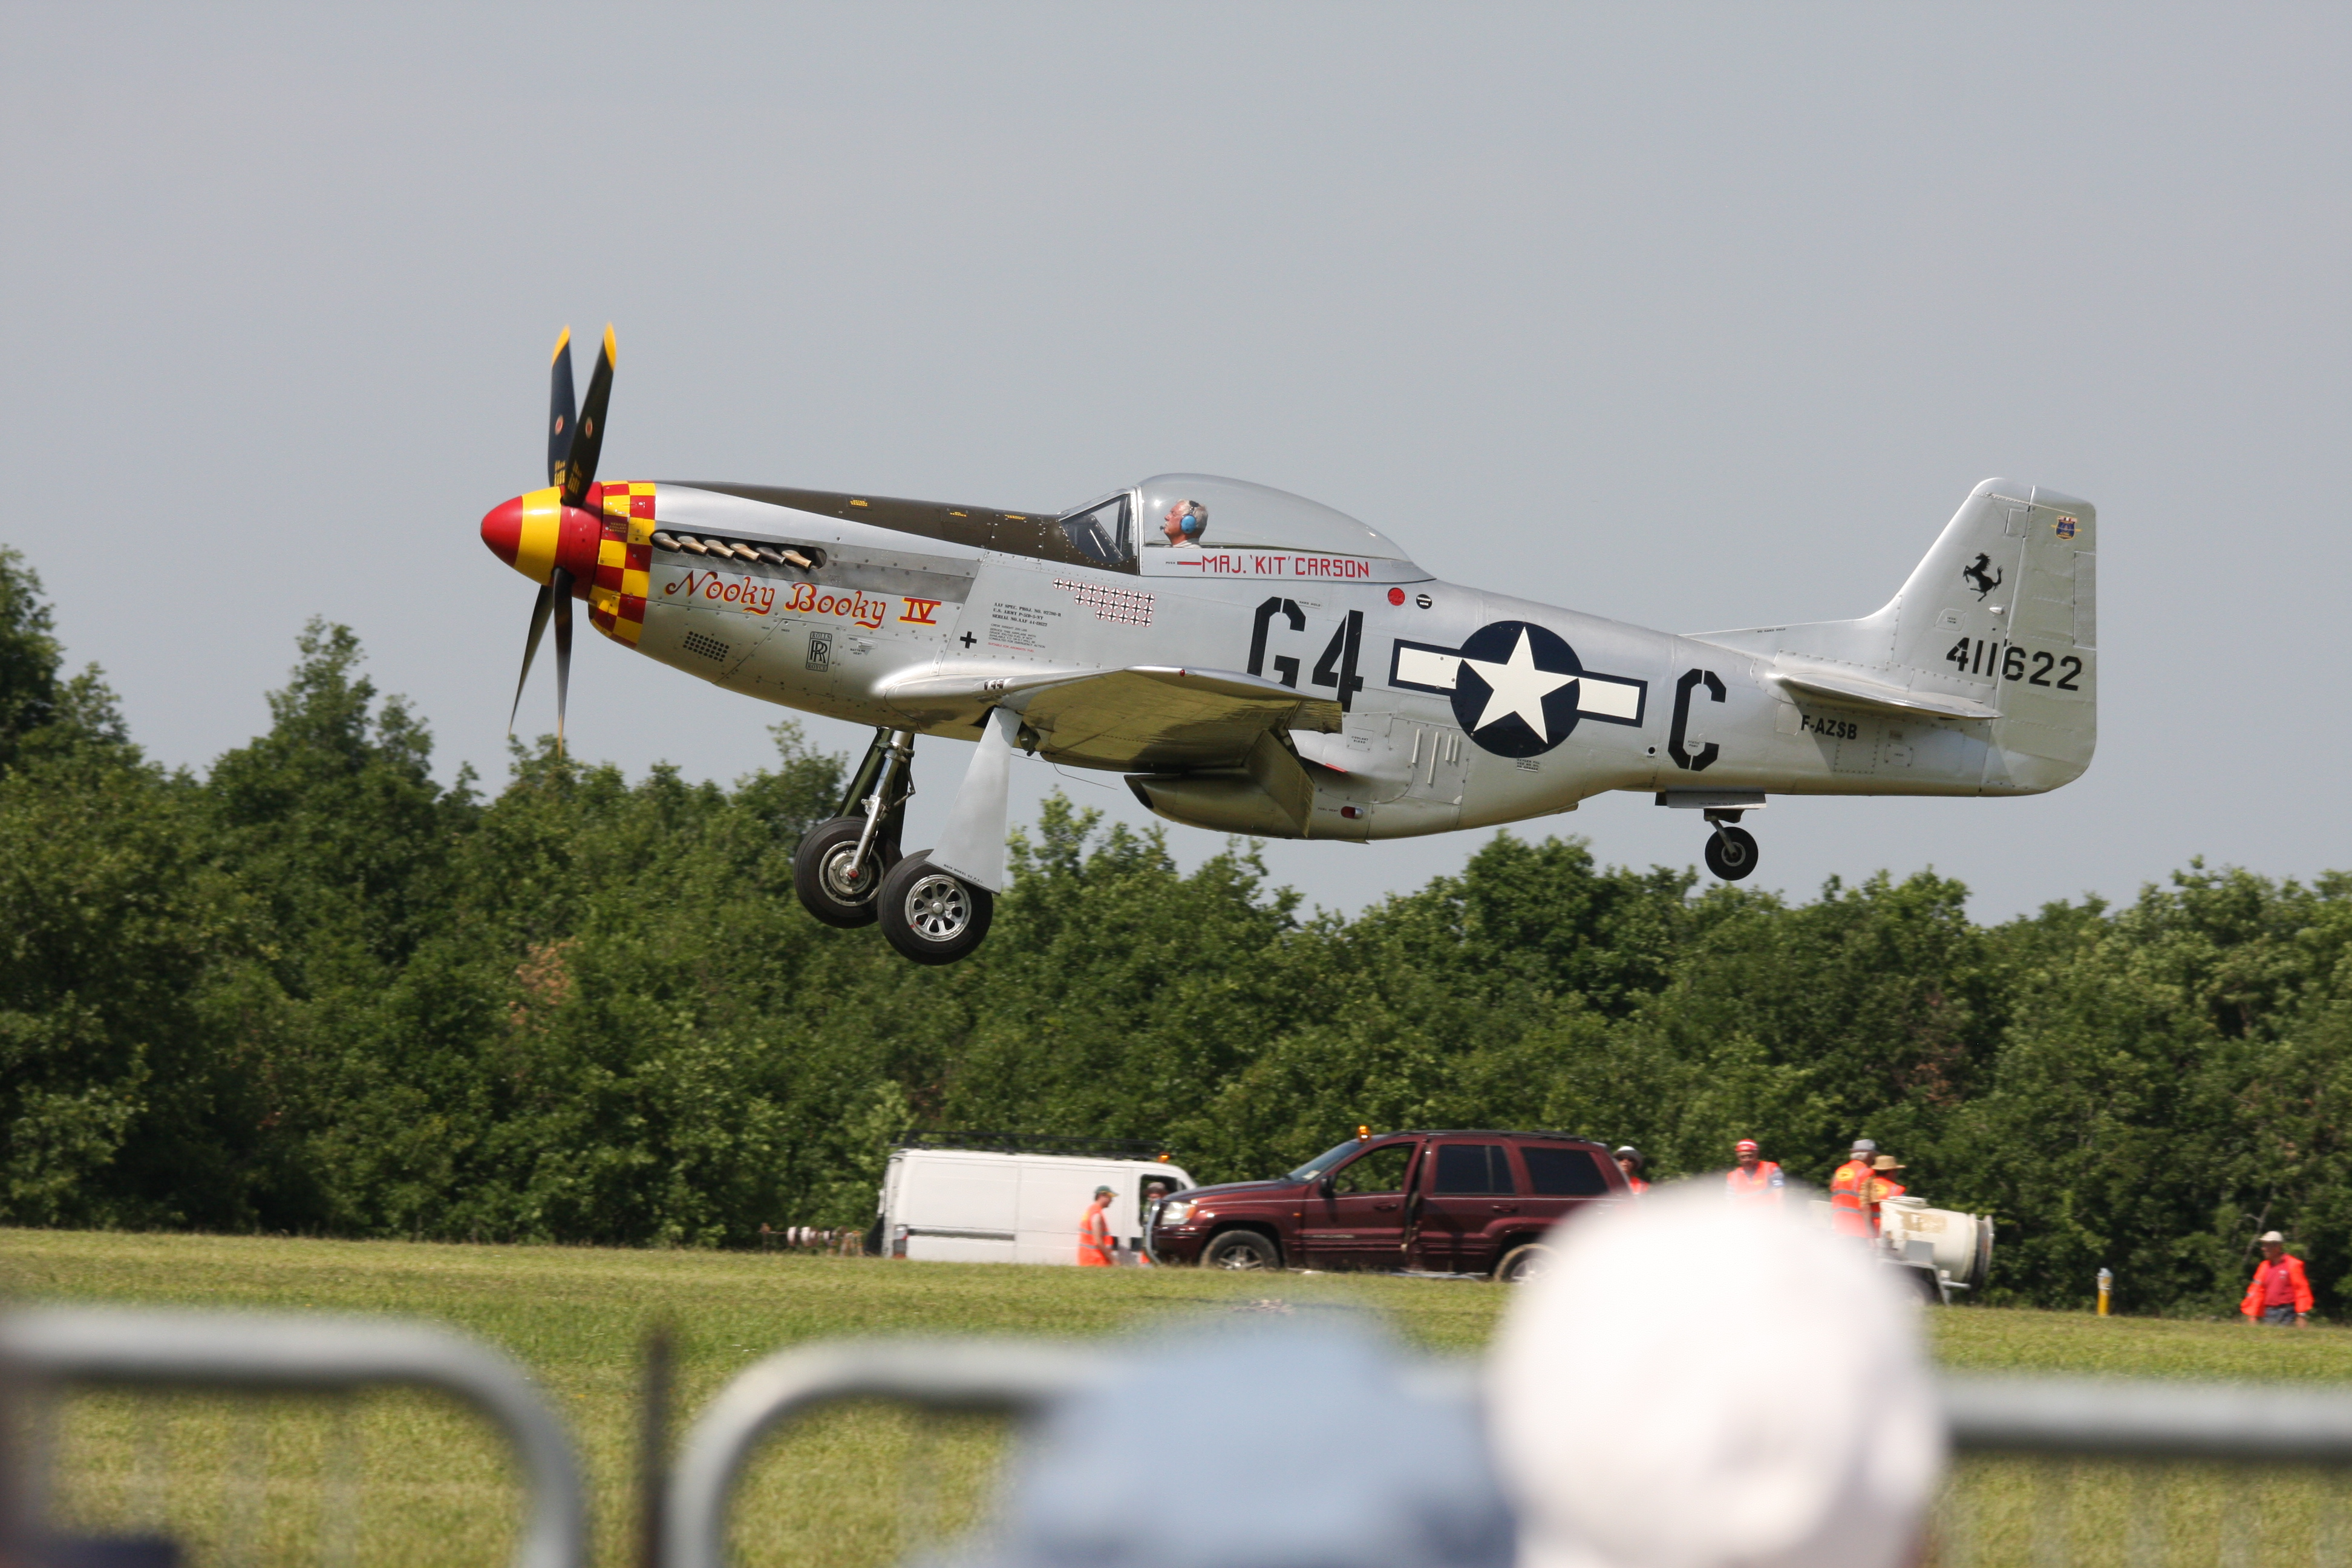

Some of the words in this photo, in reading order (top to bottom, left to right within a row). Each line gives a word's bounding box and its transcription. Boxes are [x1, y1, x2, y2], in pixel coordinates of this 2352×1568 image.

[1202, 555, 1247, 574] MAJ.
[1295, 557, 1370, 578] CARSON
[664, 570, 776, 615] Nooky
[784, 582, 887, 629] Booky
[897, 596, 942, 626] IV
[1247, 596, 1364, 713] G4
[1945, 637, 2082, 691] 411622
[1668, 668, 1726, 772] C
[1800, 714, 1858, 740] F-AZSB
